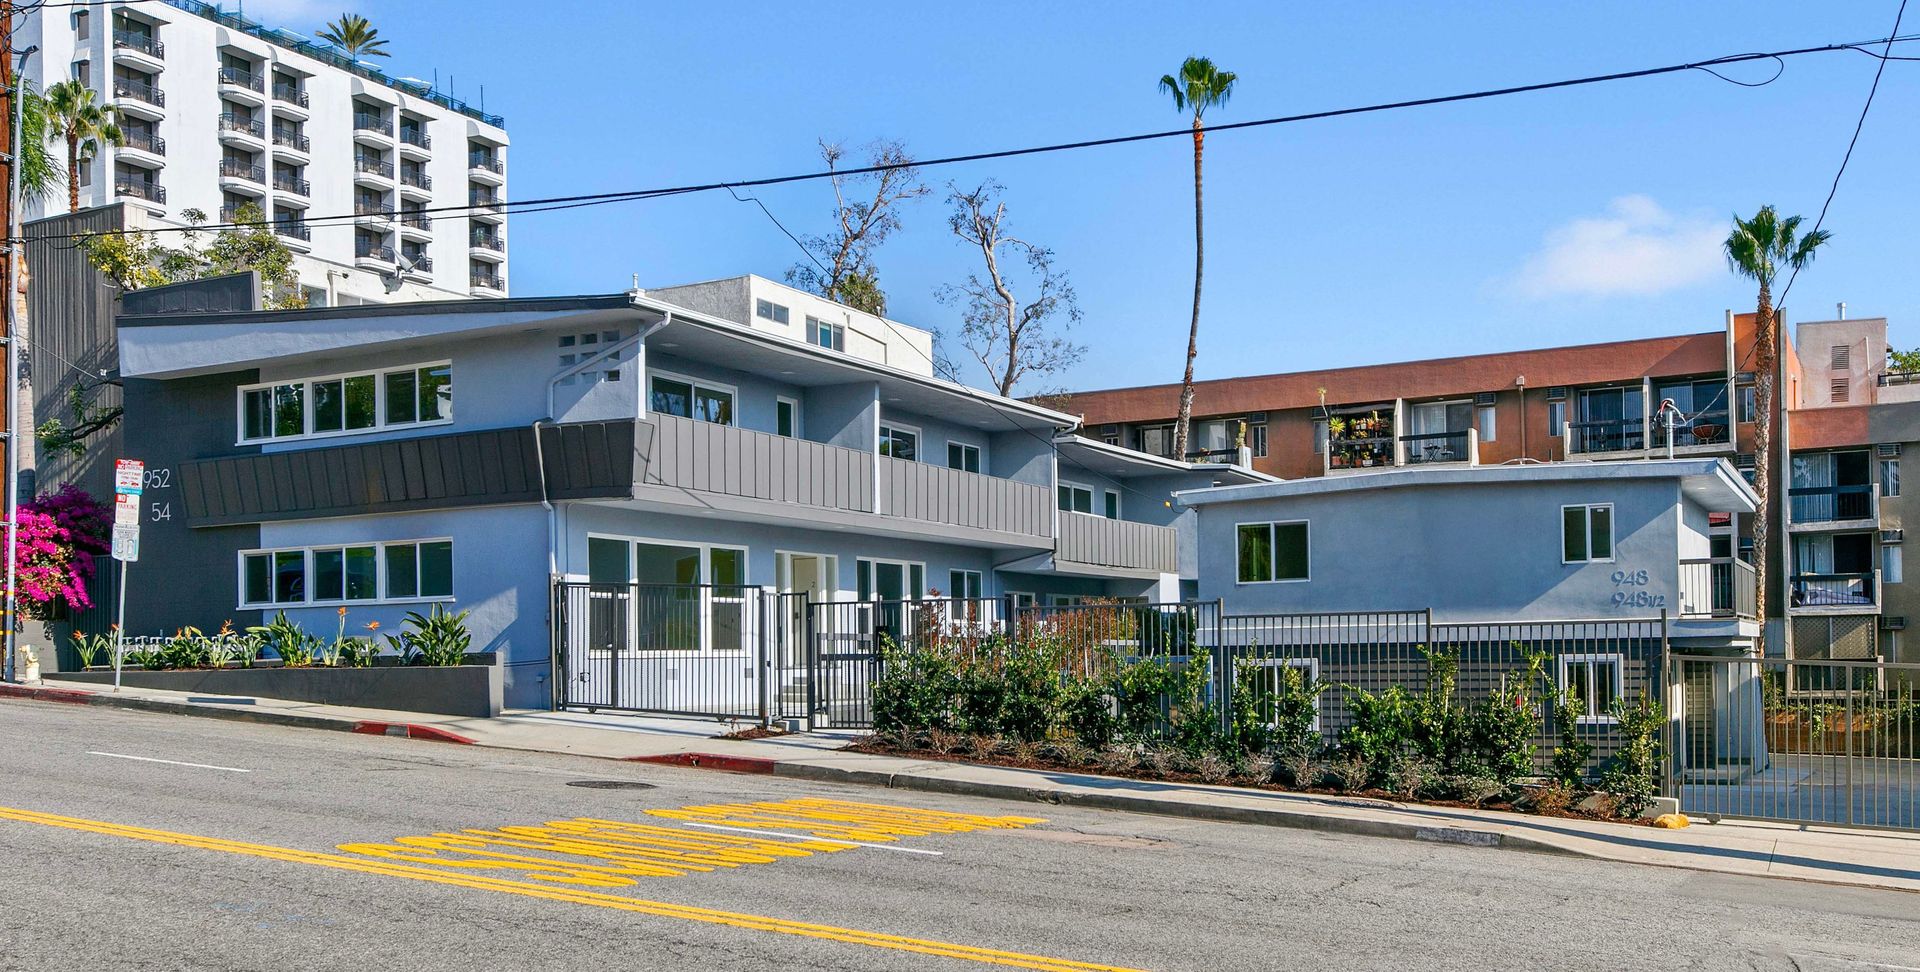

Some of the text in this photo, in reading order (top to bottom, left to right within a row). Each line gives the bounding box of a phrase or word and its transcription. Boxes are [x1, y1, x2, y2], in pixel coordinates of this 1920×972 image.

[144, 469, 170, 488] 952
[152, 502, 171, 521] 54
[1611, 570, 1649, 587] 948
[335, 817, 860, 888] SCHOOL
